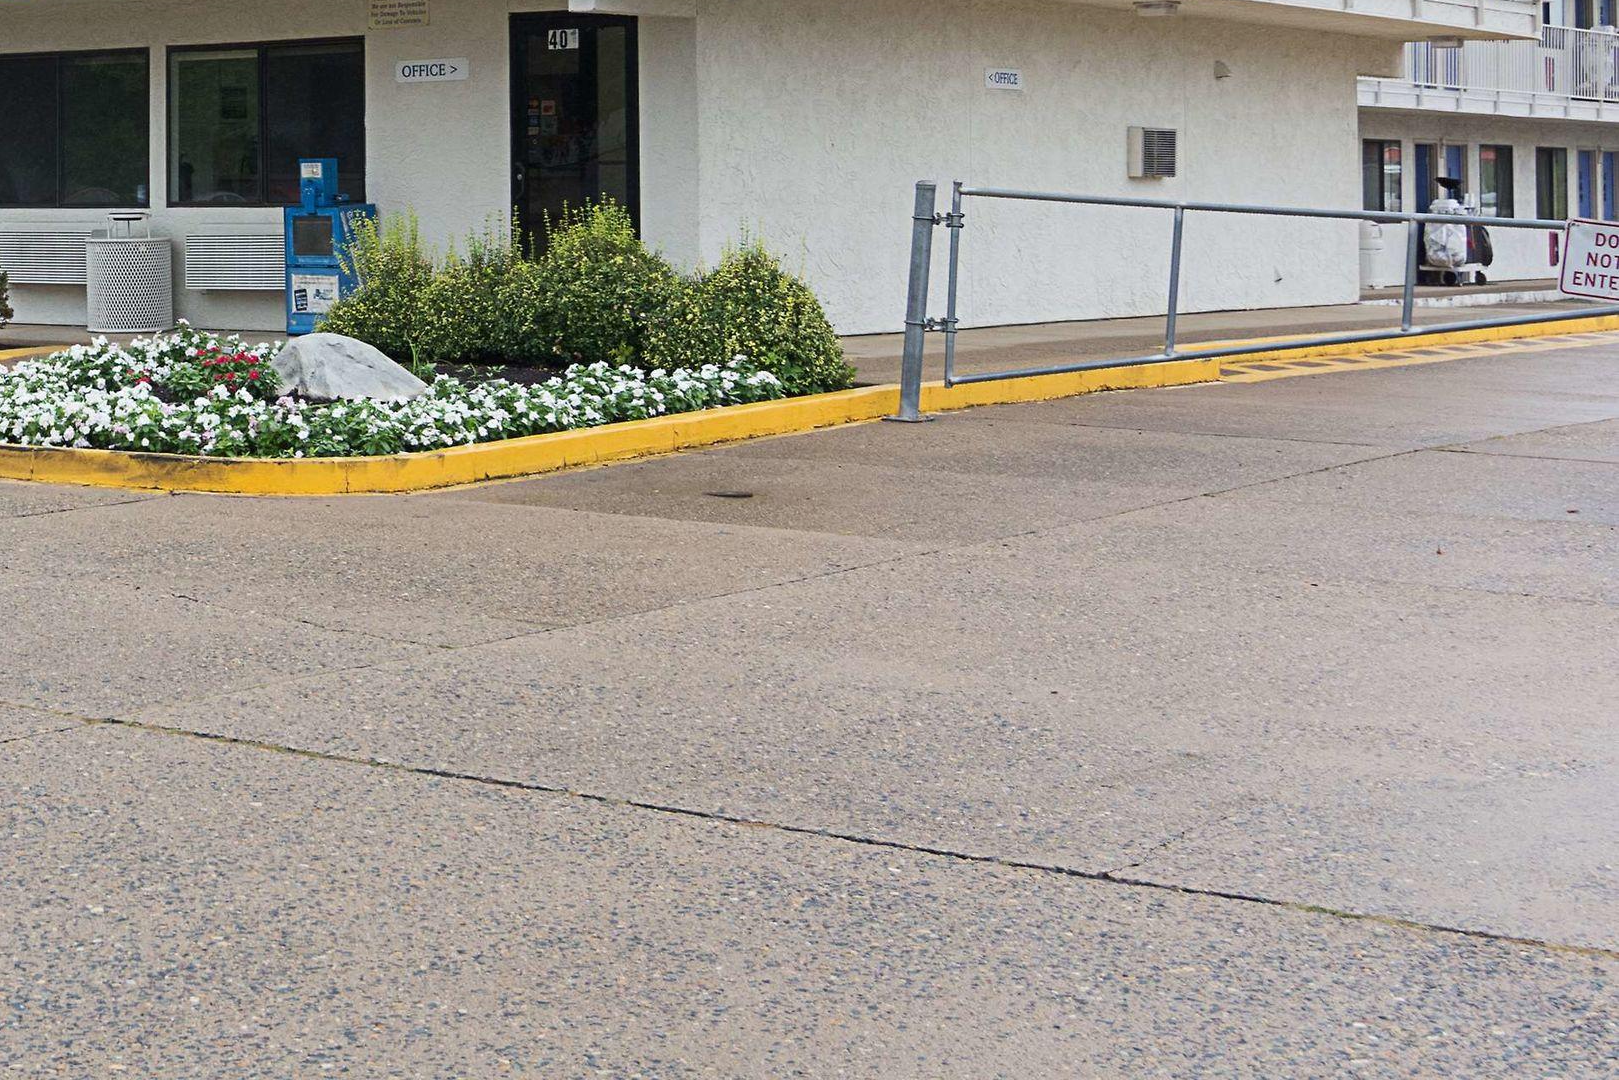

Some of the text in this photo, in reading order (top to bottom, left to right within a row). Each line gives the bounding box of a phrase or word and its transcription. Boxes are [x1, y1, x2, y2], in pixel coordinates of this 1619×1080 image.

[401, 63, 446, 78] OFFICE
[994, 71, 1018, 85] OFFICE
[1595, 232, 1619, 249] DO
[1586, 252, 1619, 269] NOT
[1572, 271, 1619, 291] ENTE
